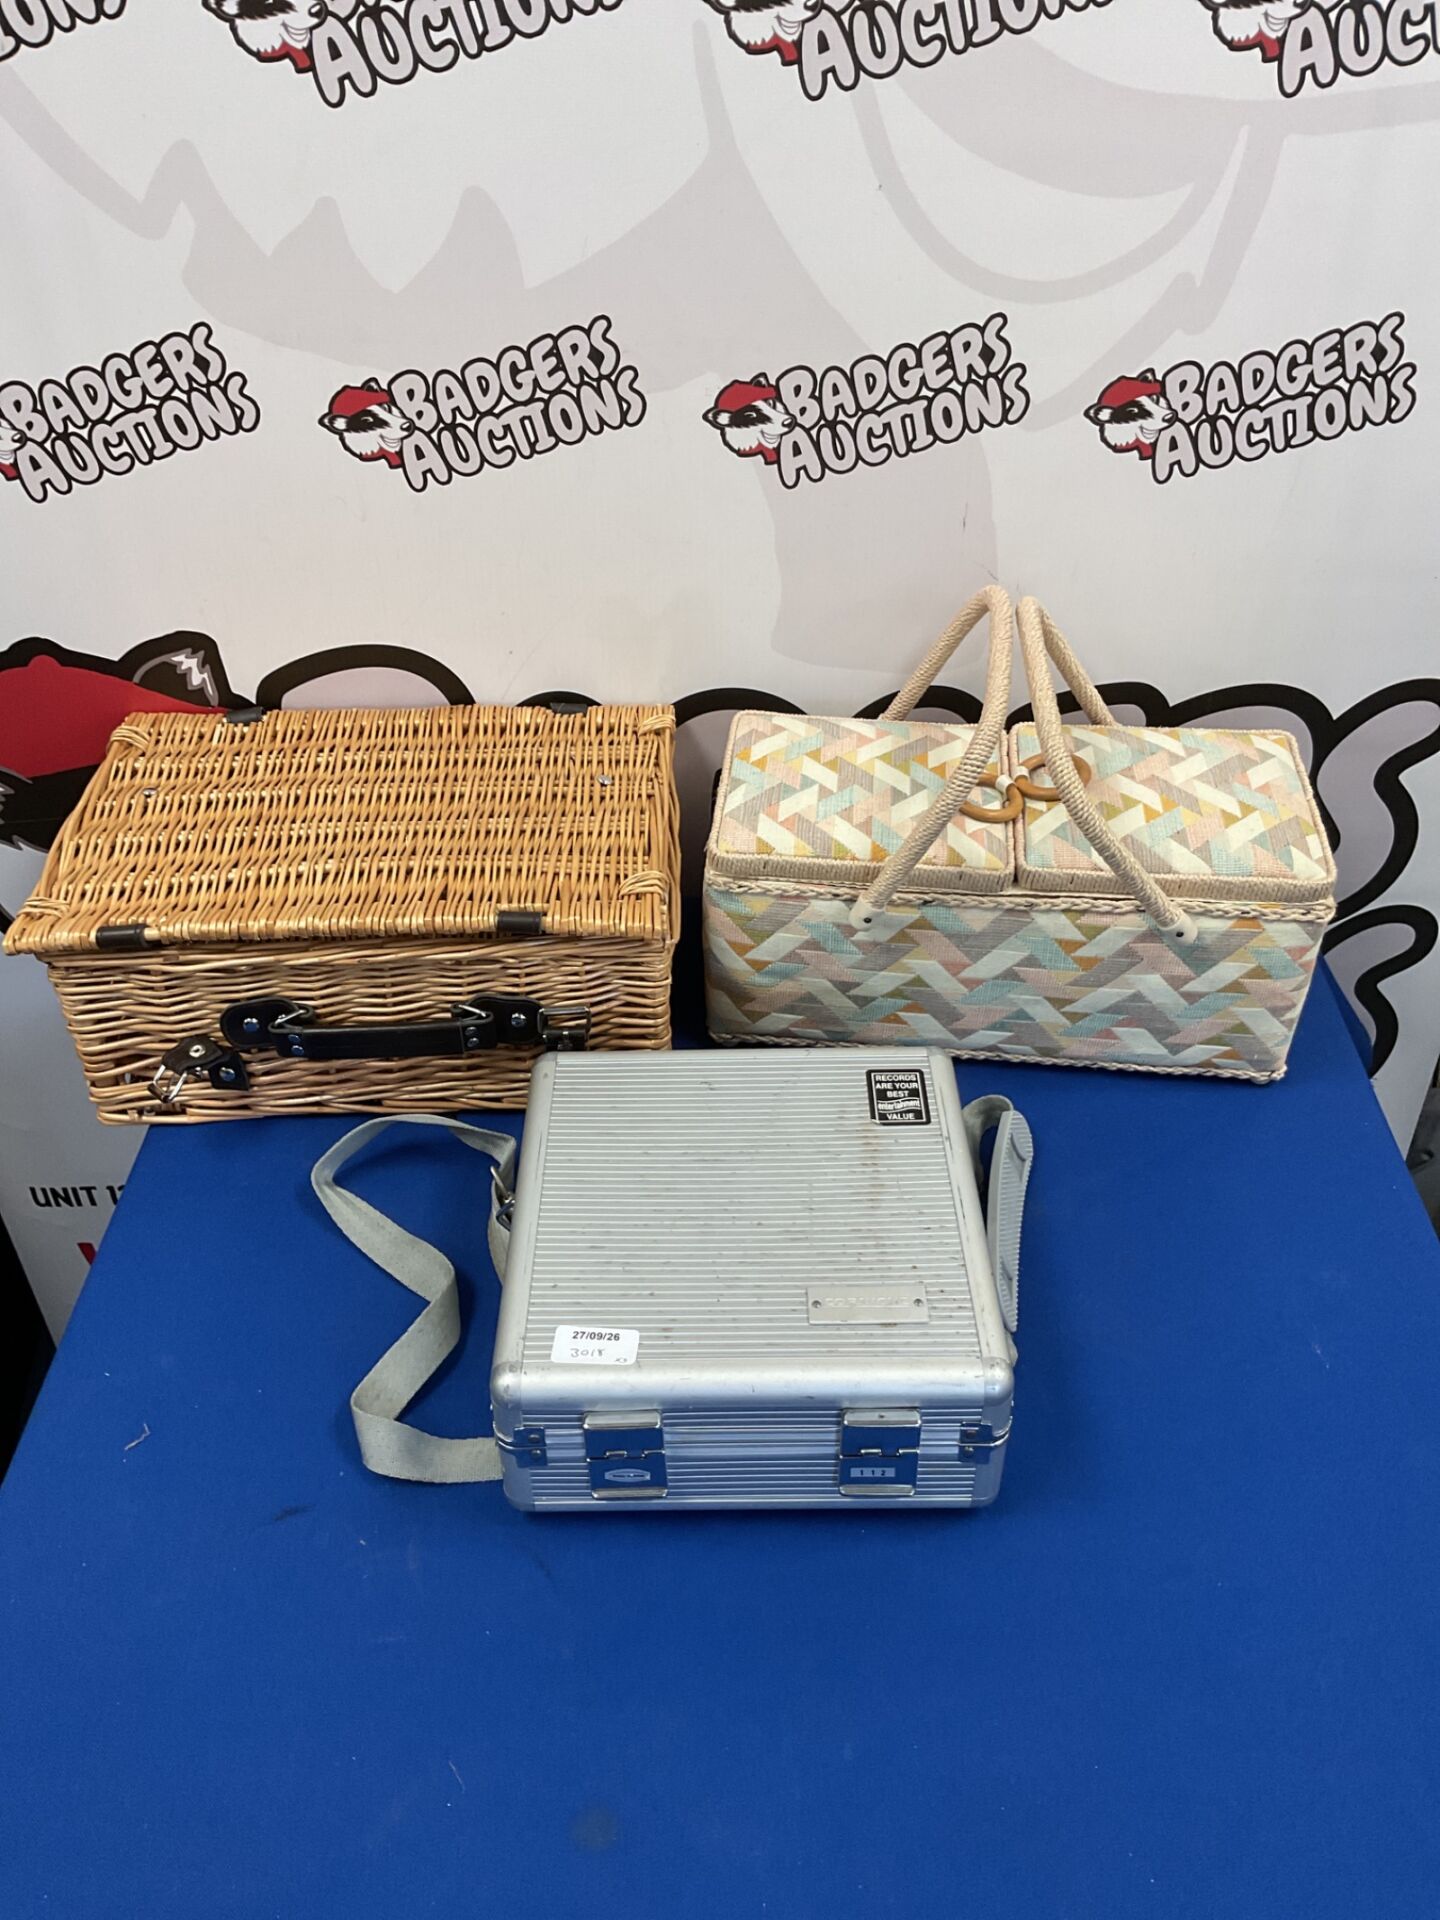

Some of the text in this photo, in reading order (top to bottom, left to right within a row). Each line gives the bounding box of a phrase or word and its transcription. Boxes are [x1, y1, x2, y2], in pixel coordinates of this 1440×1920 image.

[0, 321, 227, 444] BADGERS
[387, 314, 621, 434] BADGERS
[775, 312, 1012, 431] BADGERS
[777, 363, 1031, 489] AUCTIONS
[1151, 362, 1417, 485] AUCTIONS
[1162, 311, 1406, 425] BADGERS
[16, 371, 261, 503] AUCTIONS
[400, 365, 647, 493] AUCTIONS
[875, 1074, 917, 1082] RECORDS
[875, 1082, 919, 1090] ARE YOUR
[877, 1100, 921, 1111] entertainment
[886, 1090, 909, 1098] BEST
[29, 1186, 98, 1207] UNIT
[572, 1331, 620, 1341] 27/09/26
